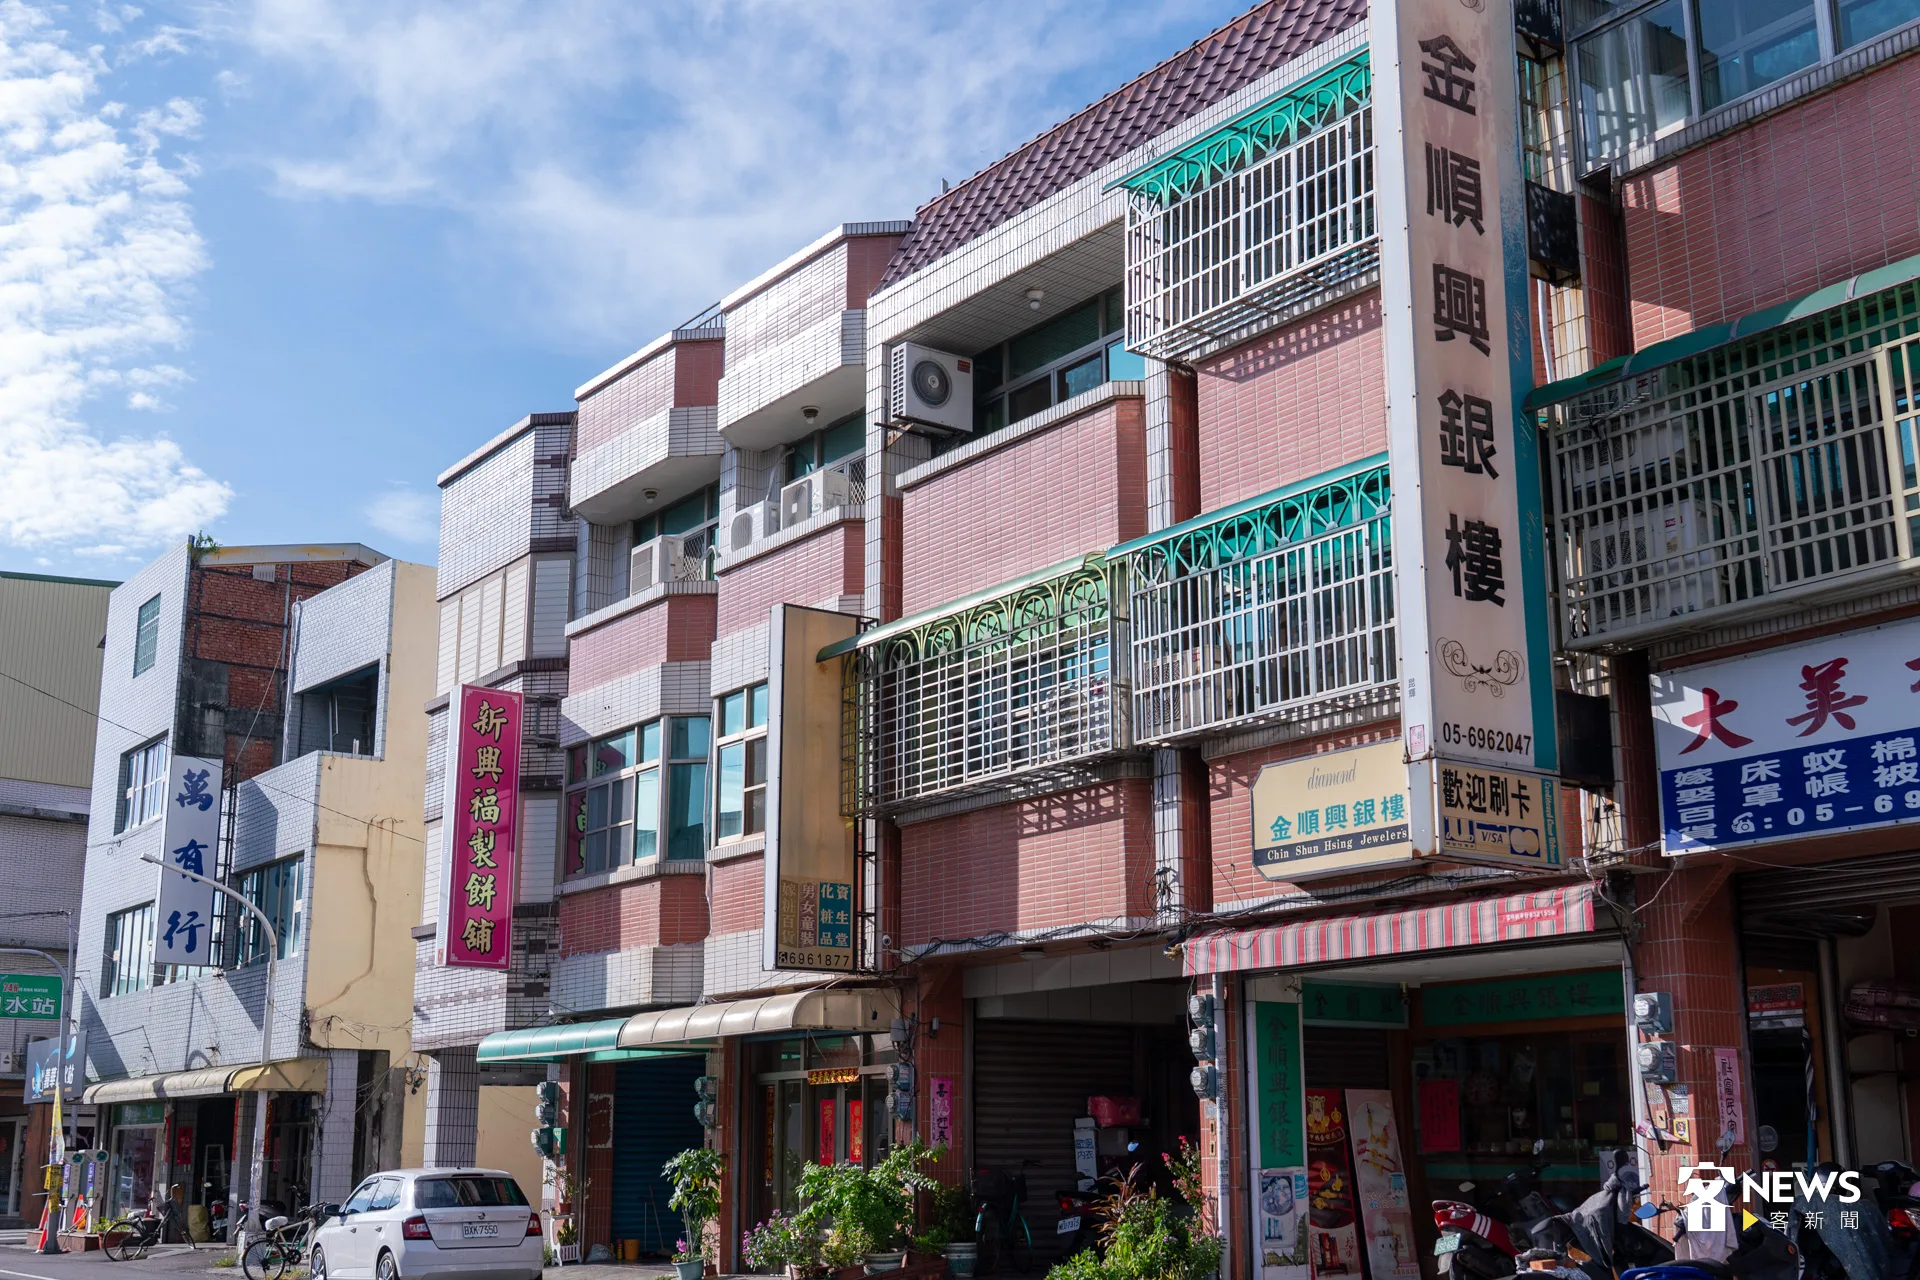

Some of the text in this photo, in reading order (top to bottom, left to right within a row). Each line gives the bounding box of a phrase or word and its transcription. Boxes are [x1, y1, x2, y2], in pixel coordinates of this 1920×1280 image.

[1418, 34, 1506, 607] 金順興銀樓
[1678, 657, 1920, 755] 大美
[1442, 722, 1532, 755] 05-6962047
[1870, 737, 1920, 788] 棉被
[1307, 759, 1357, 790] diamond
[1442, 768, 1530, 820] 歡迎刷卡
[1740, 759, 1784, 807] 床罩
[1802, 748, 1850, 798] 蚊帳
[1270, 793, 1405, 842] 金順興銀樓
[1481, 831, 1503, 843] VISA
[163, 768, 213, 953] 萬有行
[1267, 849, 1289, 861] Chin
[1295, 845, 1319, 856] Shun
[1324, 838, 1353, 849] Hsing
[800, 884, 815, 945] 男女童裝
[820, 884, 834, 946] 化粧品
[835, 885, 849, 947] 資生堂
[789, 952, 849, 967] 6961877
[0, 996, 56, 1015] 水站
[1267, 1015, 1294, 1157] 金順興銀樓
